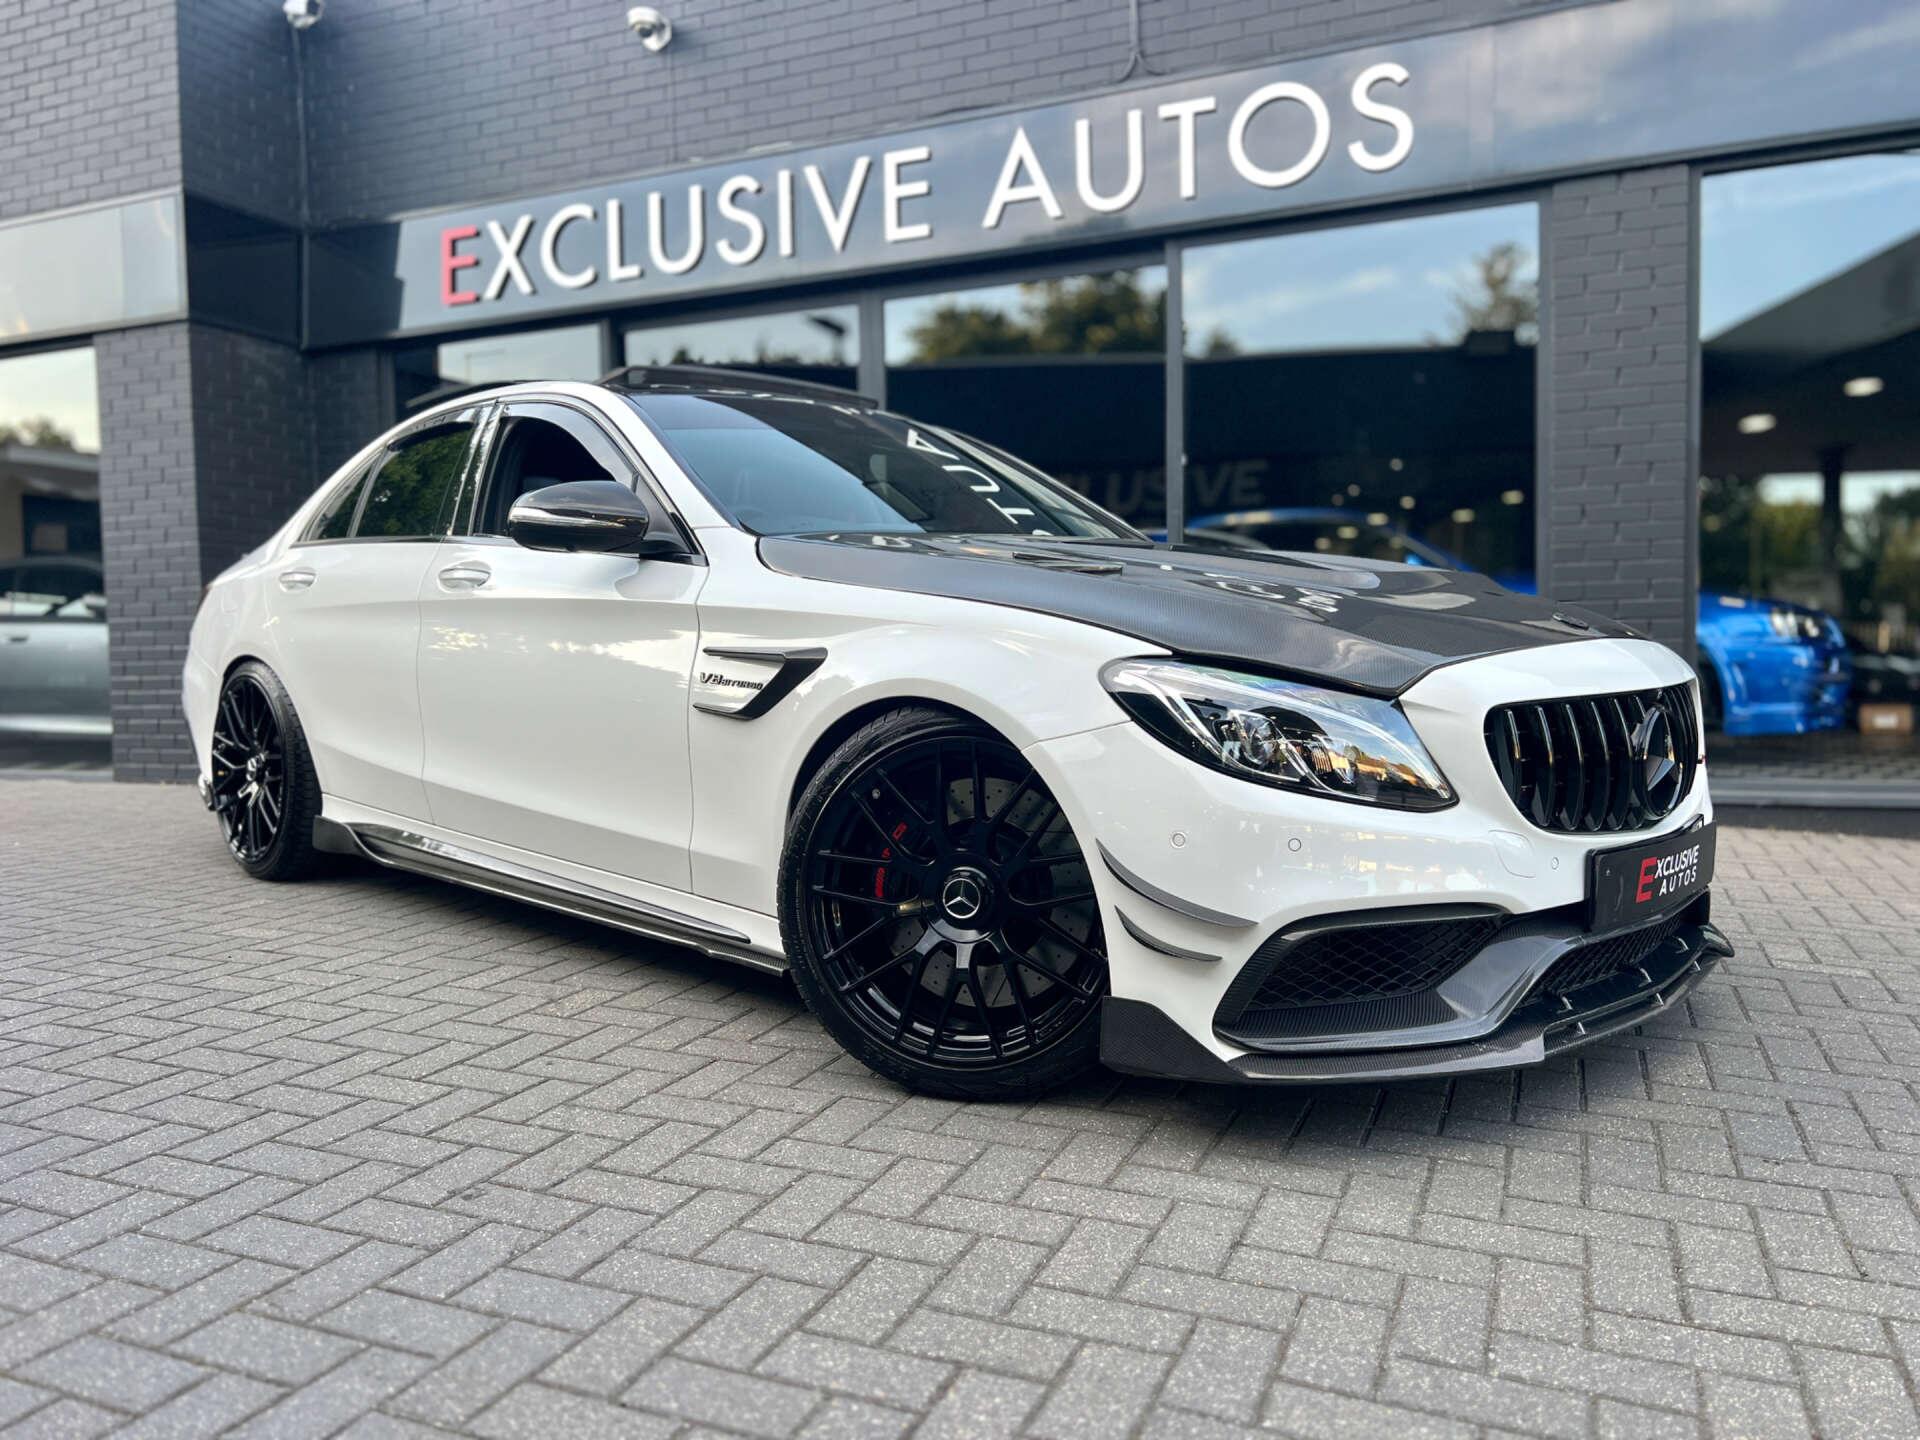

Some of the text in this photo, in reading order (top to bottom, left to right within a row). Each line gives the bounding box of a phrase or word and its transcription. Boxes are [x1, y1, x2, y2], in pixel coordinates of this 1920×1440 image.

[439, 62, 1415, 307] EXCLUSIVE AUTOS
[1635, 844, 1700, 903] EXCLUSIVE
[1659, 866, 1697, 897] AUTOS
